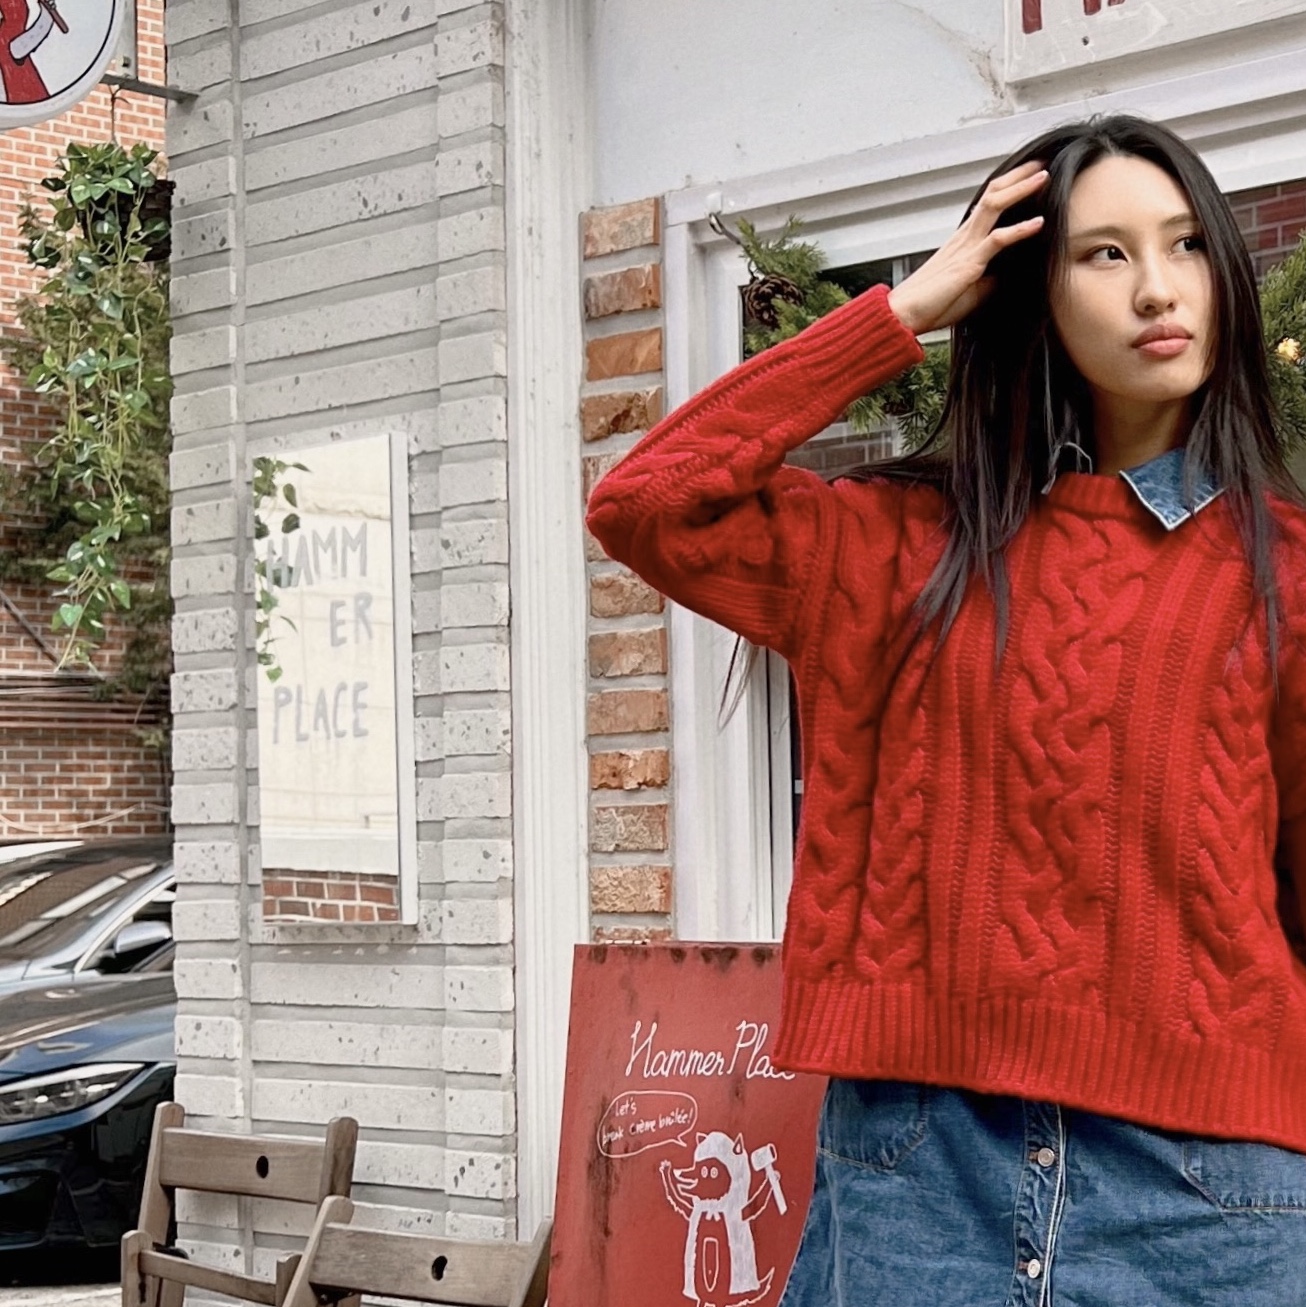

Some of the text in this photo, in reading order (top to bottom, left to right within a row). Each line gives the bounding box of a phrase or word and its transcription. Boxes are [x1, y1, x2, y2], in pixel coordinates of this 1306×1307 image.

[266, 521, 367, 593] HAMM
[330, 591, 373, 648] ER
[273, 681, 369, 745] PLACE
[625, 1020, 724, 1078] Hammer
